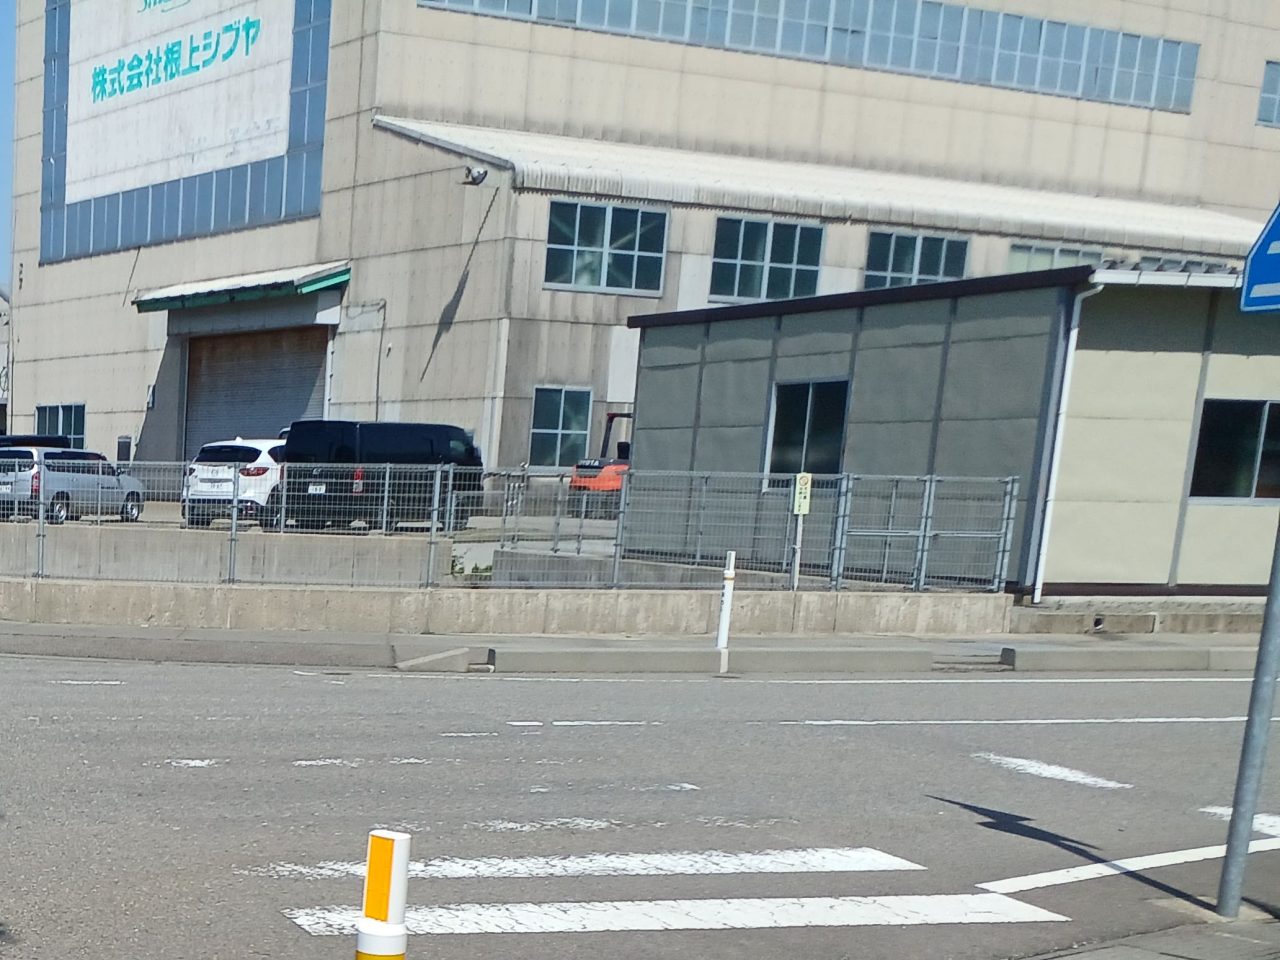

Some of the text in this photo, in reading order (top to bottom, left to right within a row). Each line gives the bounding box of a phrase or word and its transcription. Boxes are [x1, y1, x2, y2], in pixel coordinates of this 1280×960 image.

[92, 16, 261, 104] 株式会社根上シブヤ
